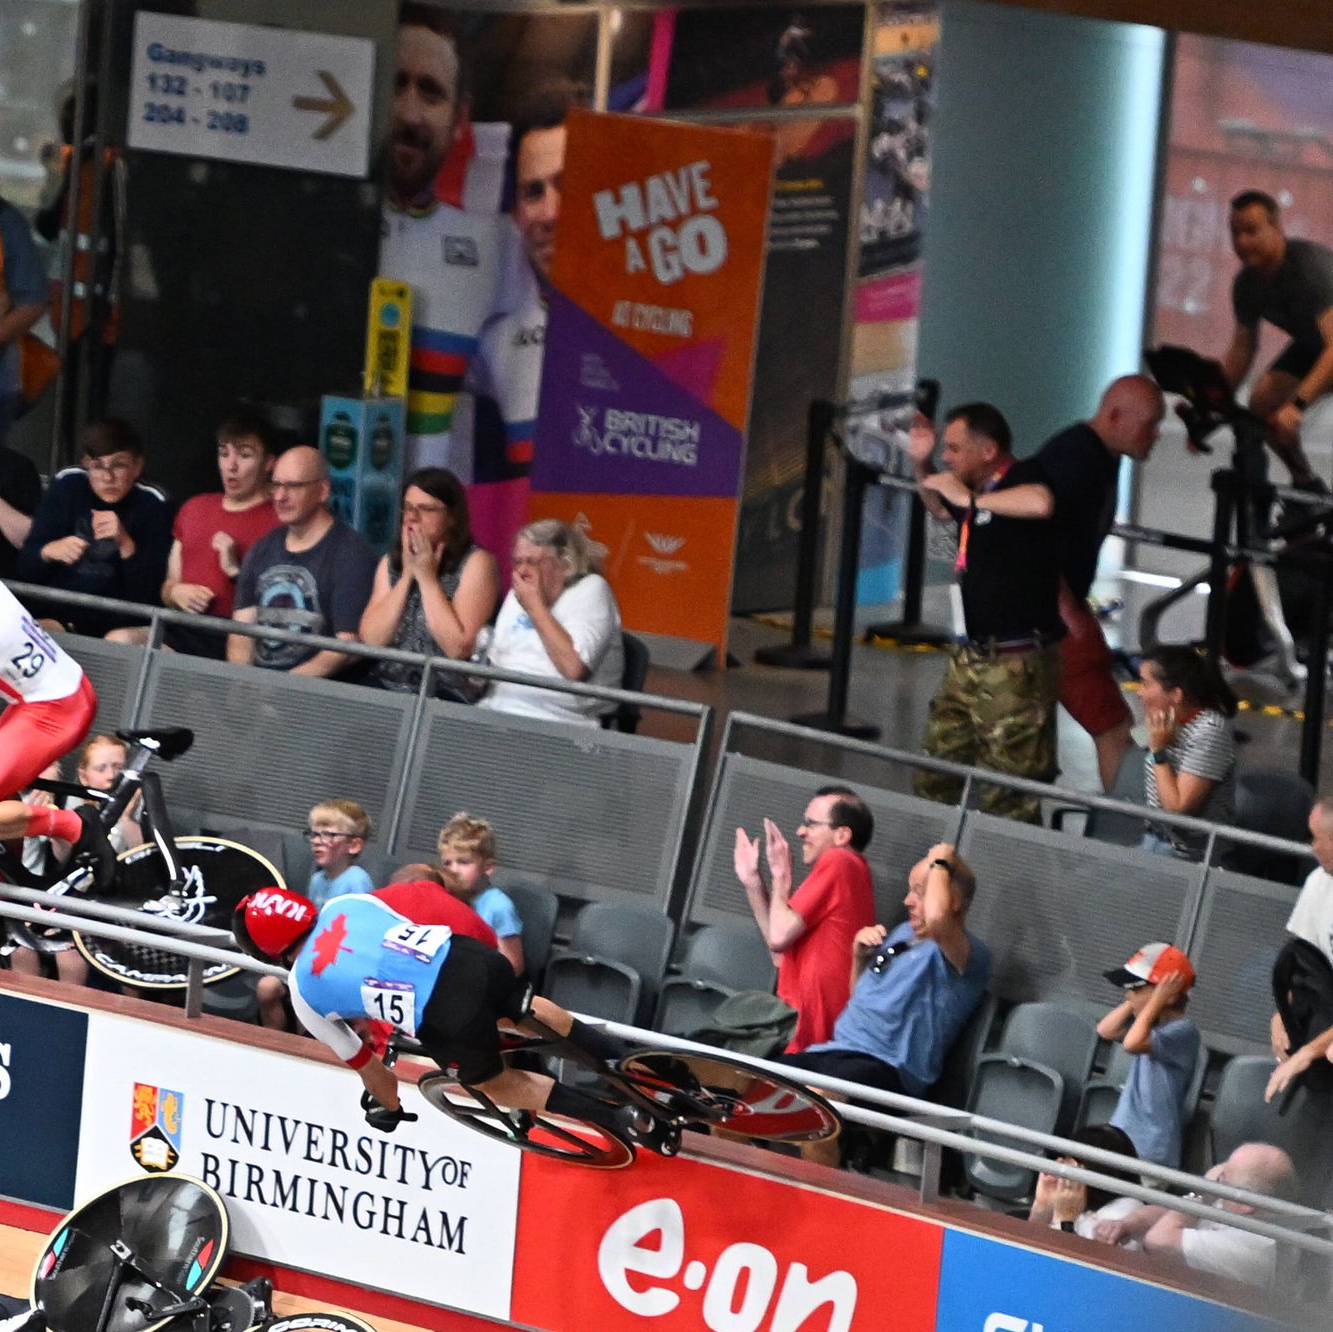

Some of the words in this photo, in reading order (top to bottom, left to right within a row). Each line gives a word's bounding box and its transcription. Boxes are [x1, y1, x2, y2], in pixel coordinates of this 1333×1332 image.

[147, 42, 266, 78] Gangways
[593, 160, 718, 240] HAVE
[626, 237, 646, 273] A
[649, 214, 728, 284] GO
[604, 408, 701, 443] BRITISH
[604, 435, 699, 467] CYCLING
[10, 641, 45, 678] 29
[373, 992, 405, 1025] 15
[204, 1098, 451, 1190] UNIVERSITY
[440, 1152, 472, 1188] OF
[201, 1152, 469, 1256] BIRMINGHAM
